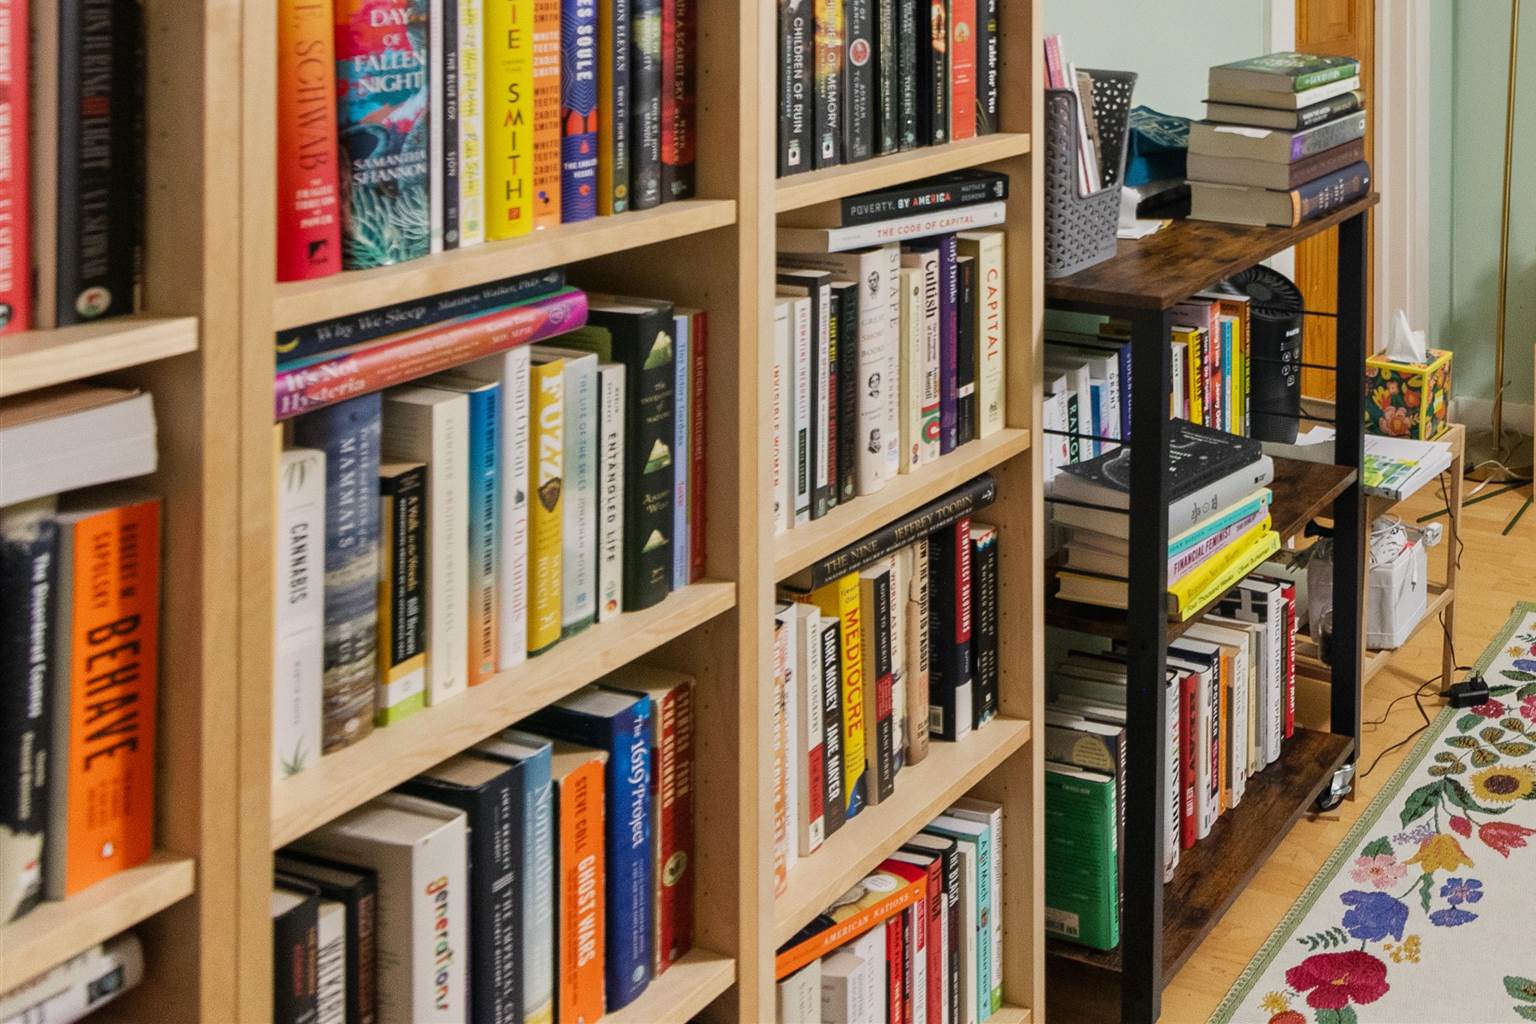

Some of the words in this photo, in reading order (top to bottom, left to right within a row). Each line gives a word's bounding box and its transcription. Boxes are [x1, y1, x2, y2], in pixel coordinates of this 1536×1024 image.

[370, 9, 412, 28] DAY
[382, 34, 401, 46] OF
[576, 25, 593, 81] SOULE
[616, 24, 626, 72] ELEVEN
[675, 33, 686, 76] SCARLET
[792, 17, 804, 79] CHILDREN
[987, 36, 996, 68] Table
[353, 49, 426, 73] FALLEN
[447, 50, 457, 70] THE
[987, 70, 996, 87] for
[358, 70, 424, 95] NIGHT
[447, 72, 457, 97] BLUE
[675, 80, 686, 101] SKY
[792, 82, 804, 100] OF
[826, 72, 836, 128] MEMORY
[904, 75, 912, 114] TOLKIEN
[987, 88, 996, 114] Two
[447, 99, 457, 120] FOX
[792, 104, 804, 134] RUIN
[353, 150, 426, 171] SAMANTHA
[503, 82, 525, 201] SMITH
[353, 162, 426, 185] SHANNON
[850, 199, 896, 217] POVERTY.
[897, 198, 911, 210] BY
[912, 192, 953, 207] AMERICA
[877, 228, 894, 238] THE
[897, 224, 922, 235] CODE
[924, 221, 938, 231] OF
[939, 215, 975, 229] CAPITAL
[439, 292, 481, 311] Matthew
[889, 253, 900, 329] SHAPE
[925, 260, 939, 319] Cultish
[949, 265, 958, 304] Drinks
[316, 322, 354, 343] Why
[358, 314, 381, 330] We
[385, 304, 427, 326] Sleep
[986, 268, 999, 361] CAPITAL
[676, 340, 686, 365] Tiny
[280, 377, 367, 413] Hysteria
[511, 357, 529, 416] Susan
[676, 365, 686, 403] Victory
[1109, 372, 1117, 410] GRANT
[540, 373, 564, 480] FUZZ
[577, 396, 588, 419] LIFE
[676, 404, 686, 446] Gardens
[511, 422, 529, 478] Orlean
[338, 436, 357, 550] MAMMALS
[577, 460, 588, 492] SKIES
[606, 432, 618, 523] ENTANGLED
[407, 505, 418, 532] Walk
[511, 517, 528, 546] On
[894, 512, 934, 541] JEFFREY
[935, 495, 973, 519] TOOBIN
[289, 522, 309, 605] CANNABIS
[606, 531, 617, 563] LIFE
[823, 558, 848, 573] THE
[848, 539, 879, 559] NINE
[1172, 544, 1206, 575] FINANCIAL
[1204, 526, 1232, 554] FEMINIST
[407, 556, 419, 592] Woods
[511, 552, 528, 622] Animals
[537, 556, 549, 611] ROACH
[551, 555, 561, 596] MARY
[890, 574, 898, 609] WORLD
[920, 562, 929, 583] THE
[1198, 585, 1221, 603] Thousand
[1219, 574, 1234, 587] Weeks
[406, 596, 419, 614] Bill
[879, 582, 889, 613] SOUTH
[920, 585, 929, 616] WORD
[962, 584, 971, 633] SOLUTIONS
[404, 615, 419, 655] Bryson
[880, 617, 889, 628] TO
[920, 617, 929, 630] IS
[1273, 597, 1281, 642] PRINCE
[823, 628, 837, 665] DARK
[880, 631, 889, 673] AMERICA
[919, 633, 929, 673] PASSED
[844, 608, 861, 740] MEDIOCRE
[1211, 657, 1220, 681] AMY
[1273, 648, 1281, 690] HARRY
[82, 613, 142, 773] BEHAVE
[824, 665, 838, 713] MONEY
[1211, 684, 1220, 737] POEHLER
[1273, 699, 1281, 740] SPARE
[825, 723, 839, 756] JANE
[881, 721, 891, 750] IMANI
[628, 739, 651, 786] 1619
[826, 756, 841, 803] MAYER
[882, 752, 891, 782] PERRY
[1211, 754, 1220, 790] PLEASE
[575, 776, 588, 816] STEVE
[627, 784, 649, 849] Project
[575, 819, 588, 855] COLL
[980, 840, 989, 849] A
[948, 851, 960, 866] THE
[979, 850, 989, 865] Bit
[578, 854, 597, 915] GHOST
[948, 869, 960, 908] BLACK
[980, 870, 989, 902] Much
[823, 916, 870, 946] AMERICAN
[873, 894, 910, 918] NATIONS
[424, 875, 455, 1012] generations
[578, 912, 597, 969] WARS
[502, 925, 515, 996] IMPERIAL
